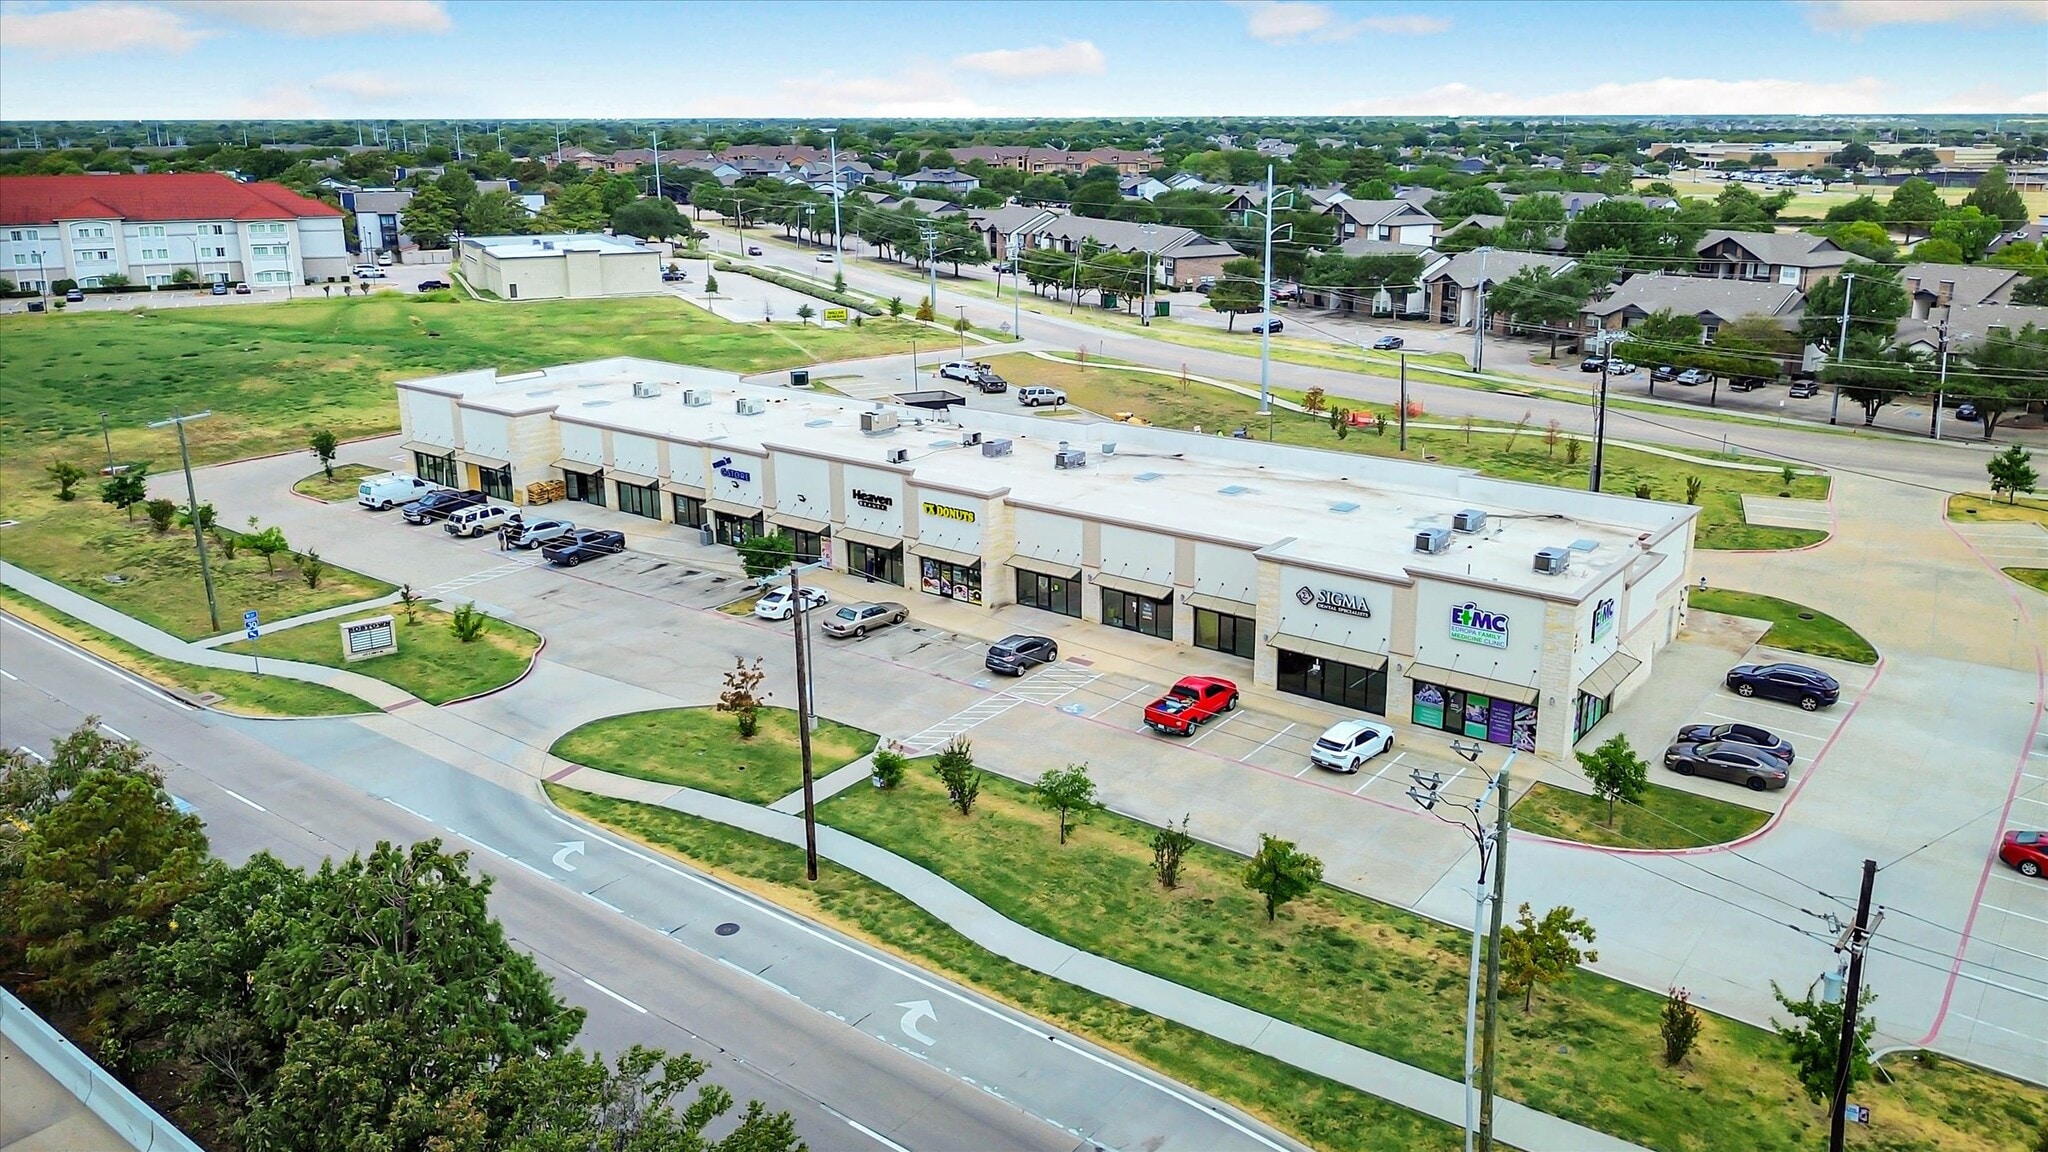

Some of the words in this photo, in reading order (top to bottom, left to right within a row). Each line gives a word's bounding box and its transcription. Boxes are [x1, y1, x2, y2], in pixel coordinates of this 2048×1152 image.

[852, 488, 893, 506] Heaven
[936, 504, 976, 523] DONUTS
[1318, 590, 1370, 612] SIGMA
[1318, 603, 1337, 612] DENTAL
[1338, 607, 1369, 617] SPECIALISTS
[1451, 631, 1483, 643] MEDICINE
[1483, 638, 1506, 648] CLINIC
[1477, 630, 1502, 640] FAMILY
